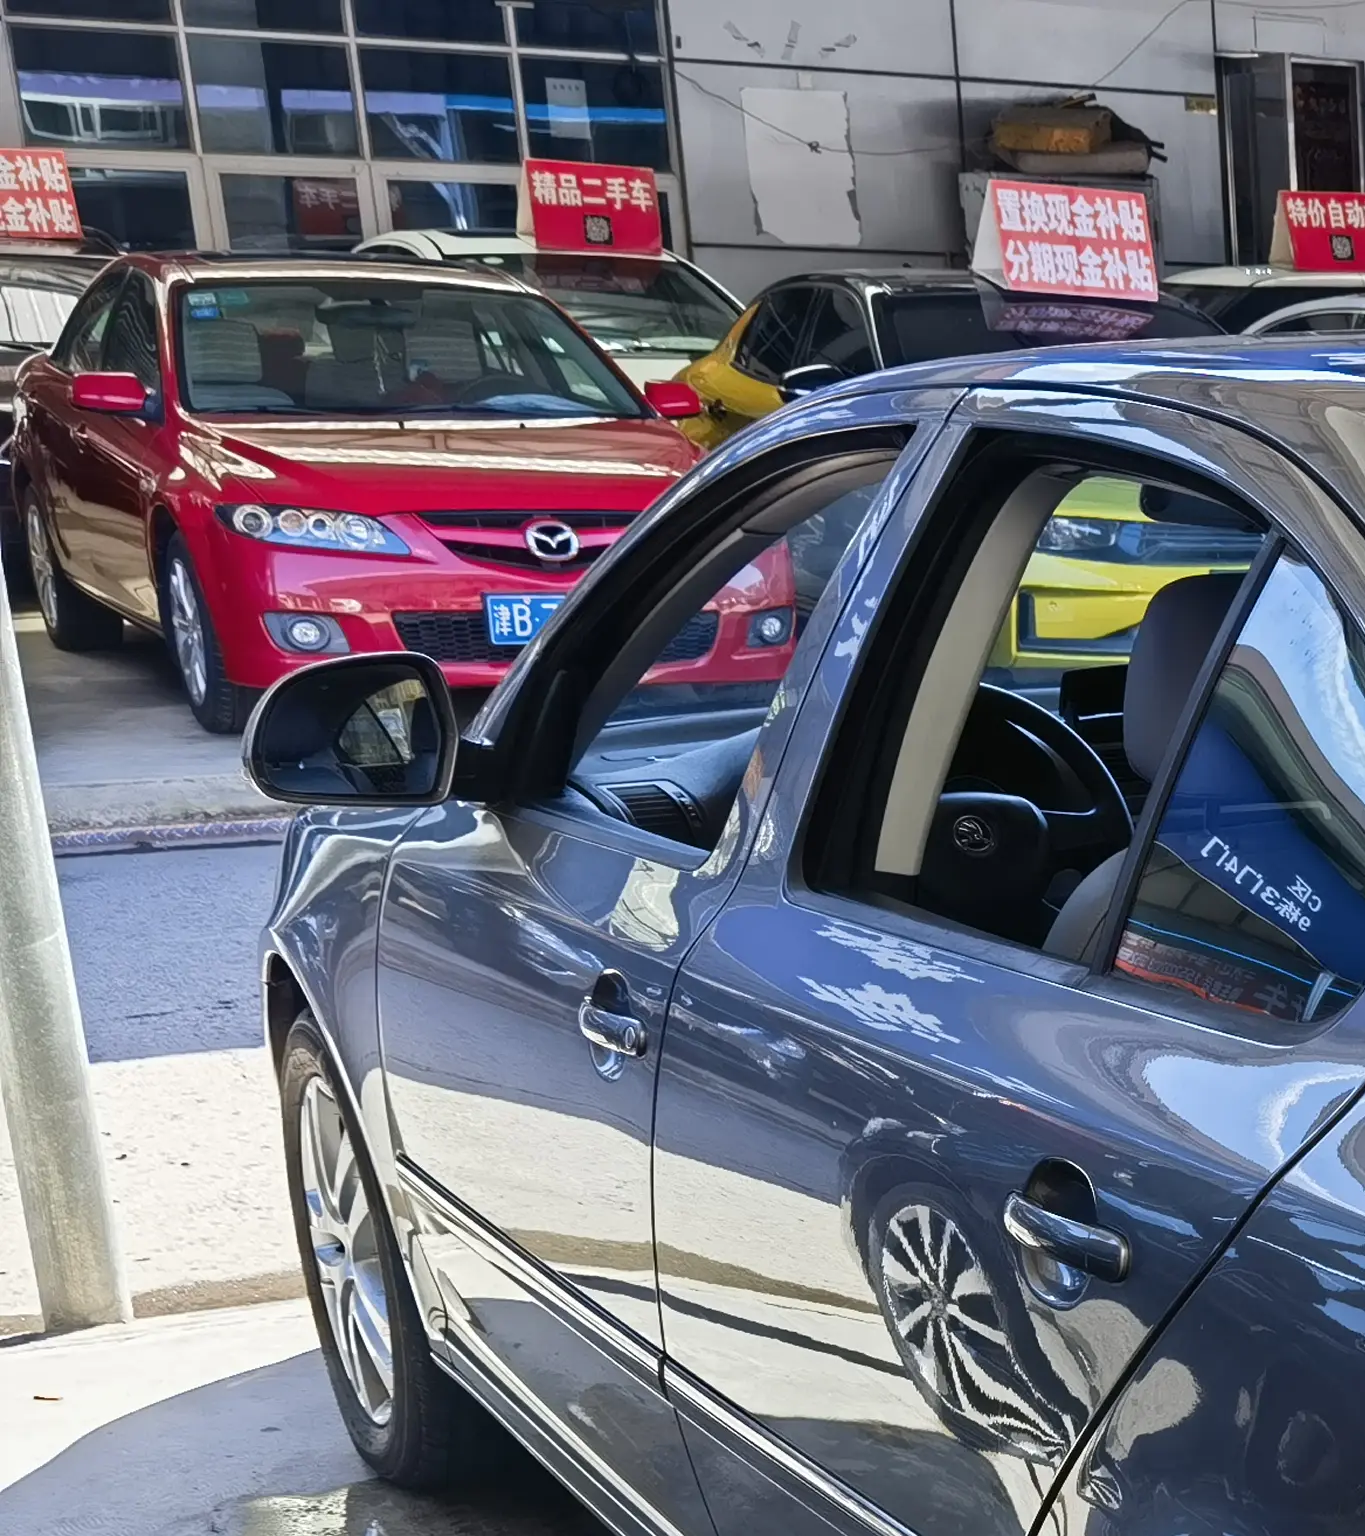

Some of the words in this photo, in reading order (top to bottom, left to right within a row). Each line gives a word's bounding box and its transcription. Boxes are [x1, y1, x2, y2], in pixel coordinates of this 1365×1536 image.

[0, 196, 79, 234] 金补贴
[531, 169, 653, 213] 精品二手车
[996, 188, 1147, 243] 置换现金补贴
[1005, 239, 1153, 292] 分期现金补贴
